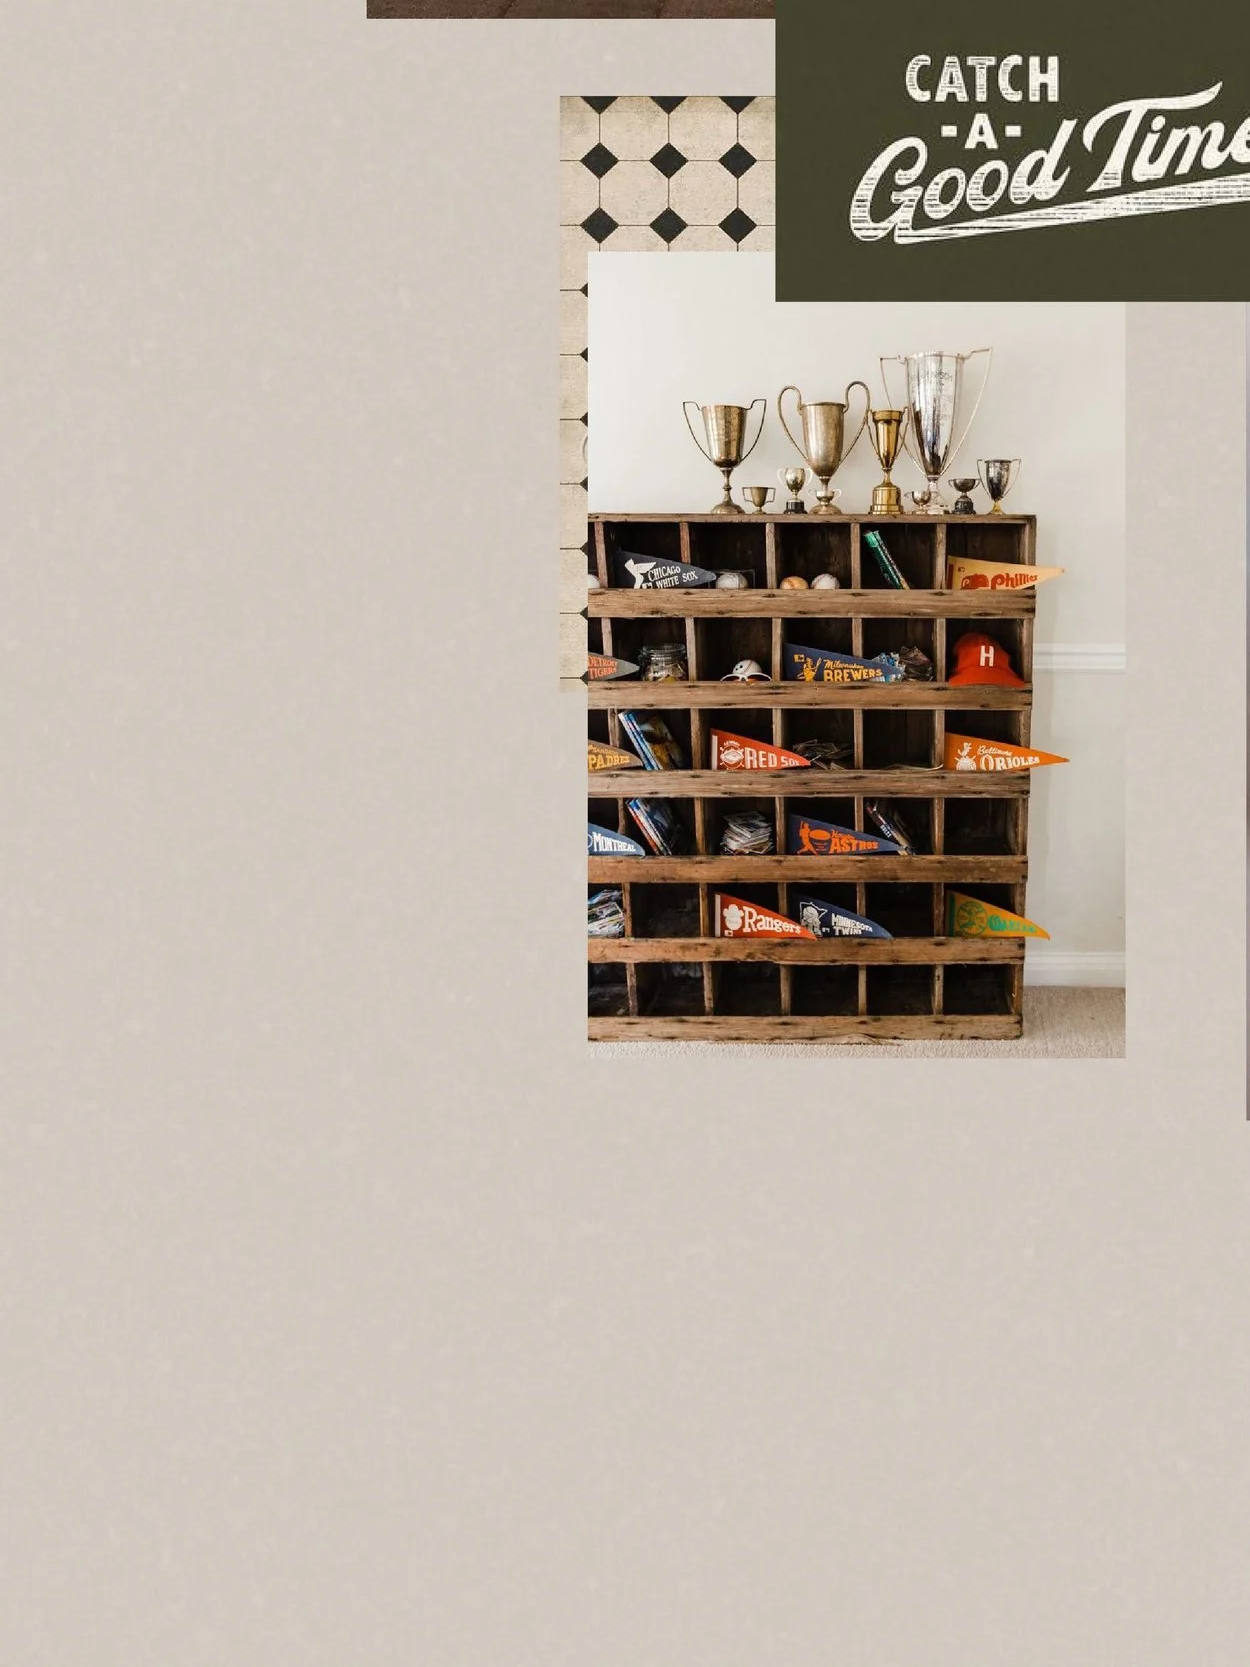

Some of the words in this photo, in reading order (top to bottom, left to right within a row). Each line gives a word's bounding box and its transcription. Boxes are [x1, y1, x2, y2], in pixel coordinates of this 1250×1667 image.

[905, 53, 1060, 103] CATCH
[848, 117, 1079, 243] Good
[647, 565, 681, 582] CHICAGO
[655, 575, 680, 589] WHITE
[681, 570, 699, 583] SOX
[980, 645, 995, 667] H
[823, 668, 884, 683] BREWERS
[588, 754, 631, 770] PADRES
[744, 746, 778, 770] RED
[981, 753, 1041, 771] ORIOLES
[592, 830, 637, 852] MONTREAL
[829, 837, 879, 855] ASTROS
[742, 905, 802, 935] Rangers
[831, 912, 874, 933] MINNESOTA
